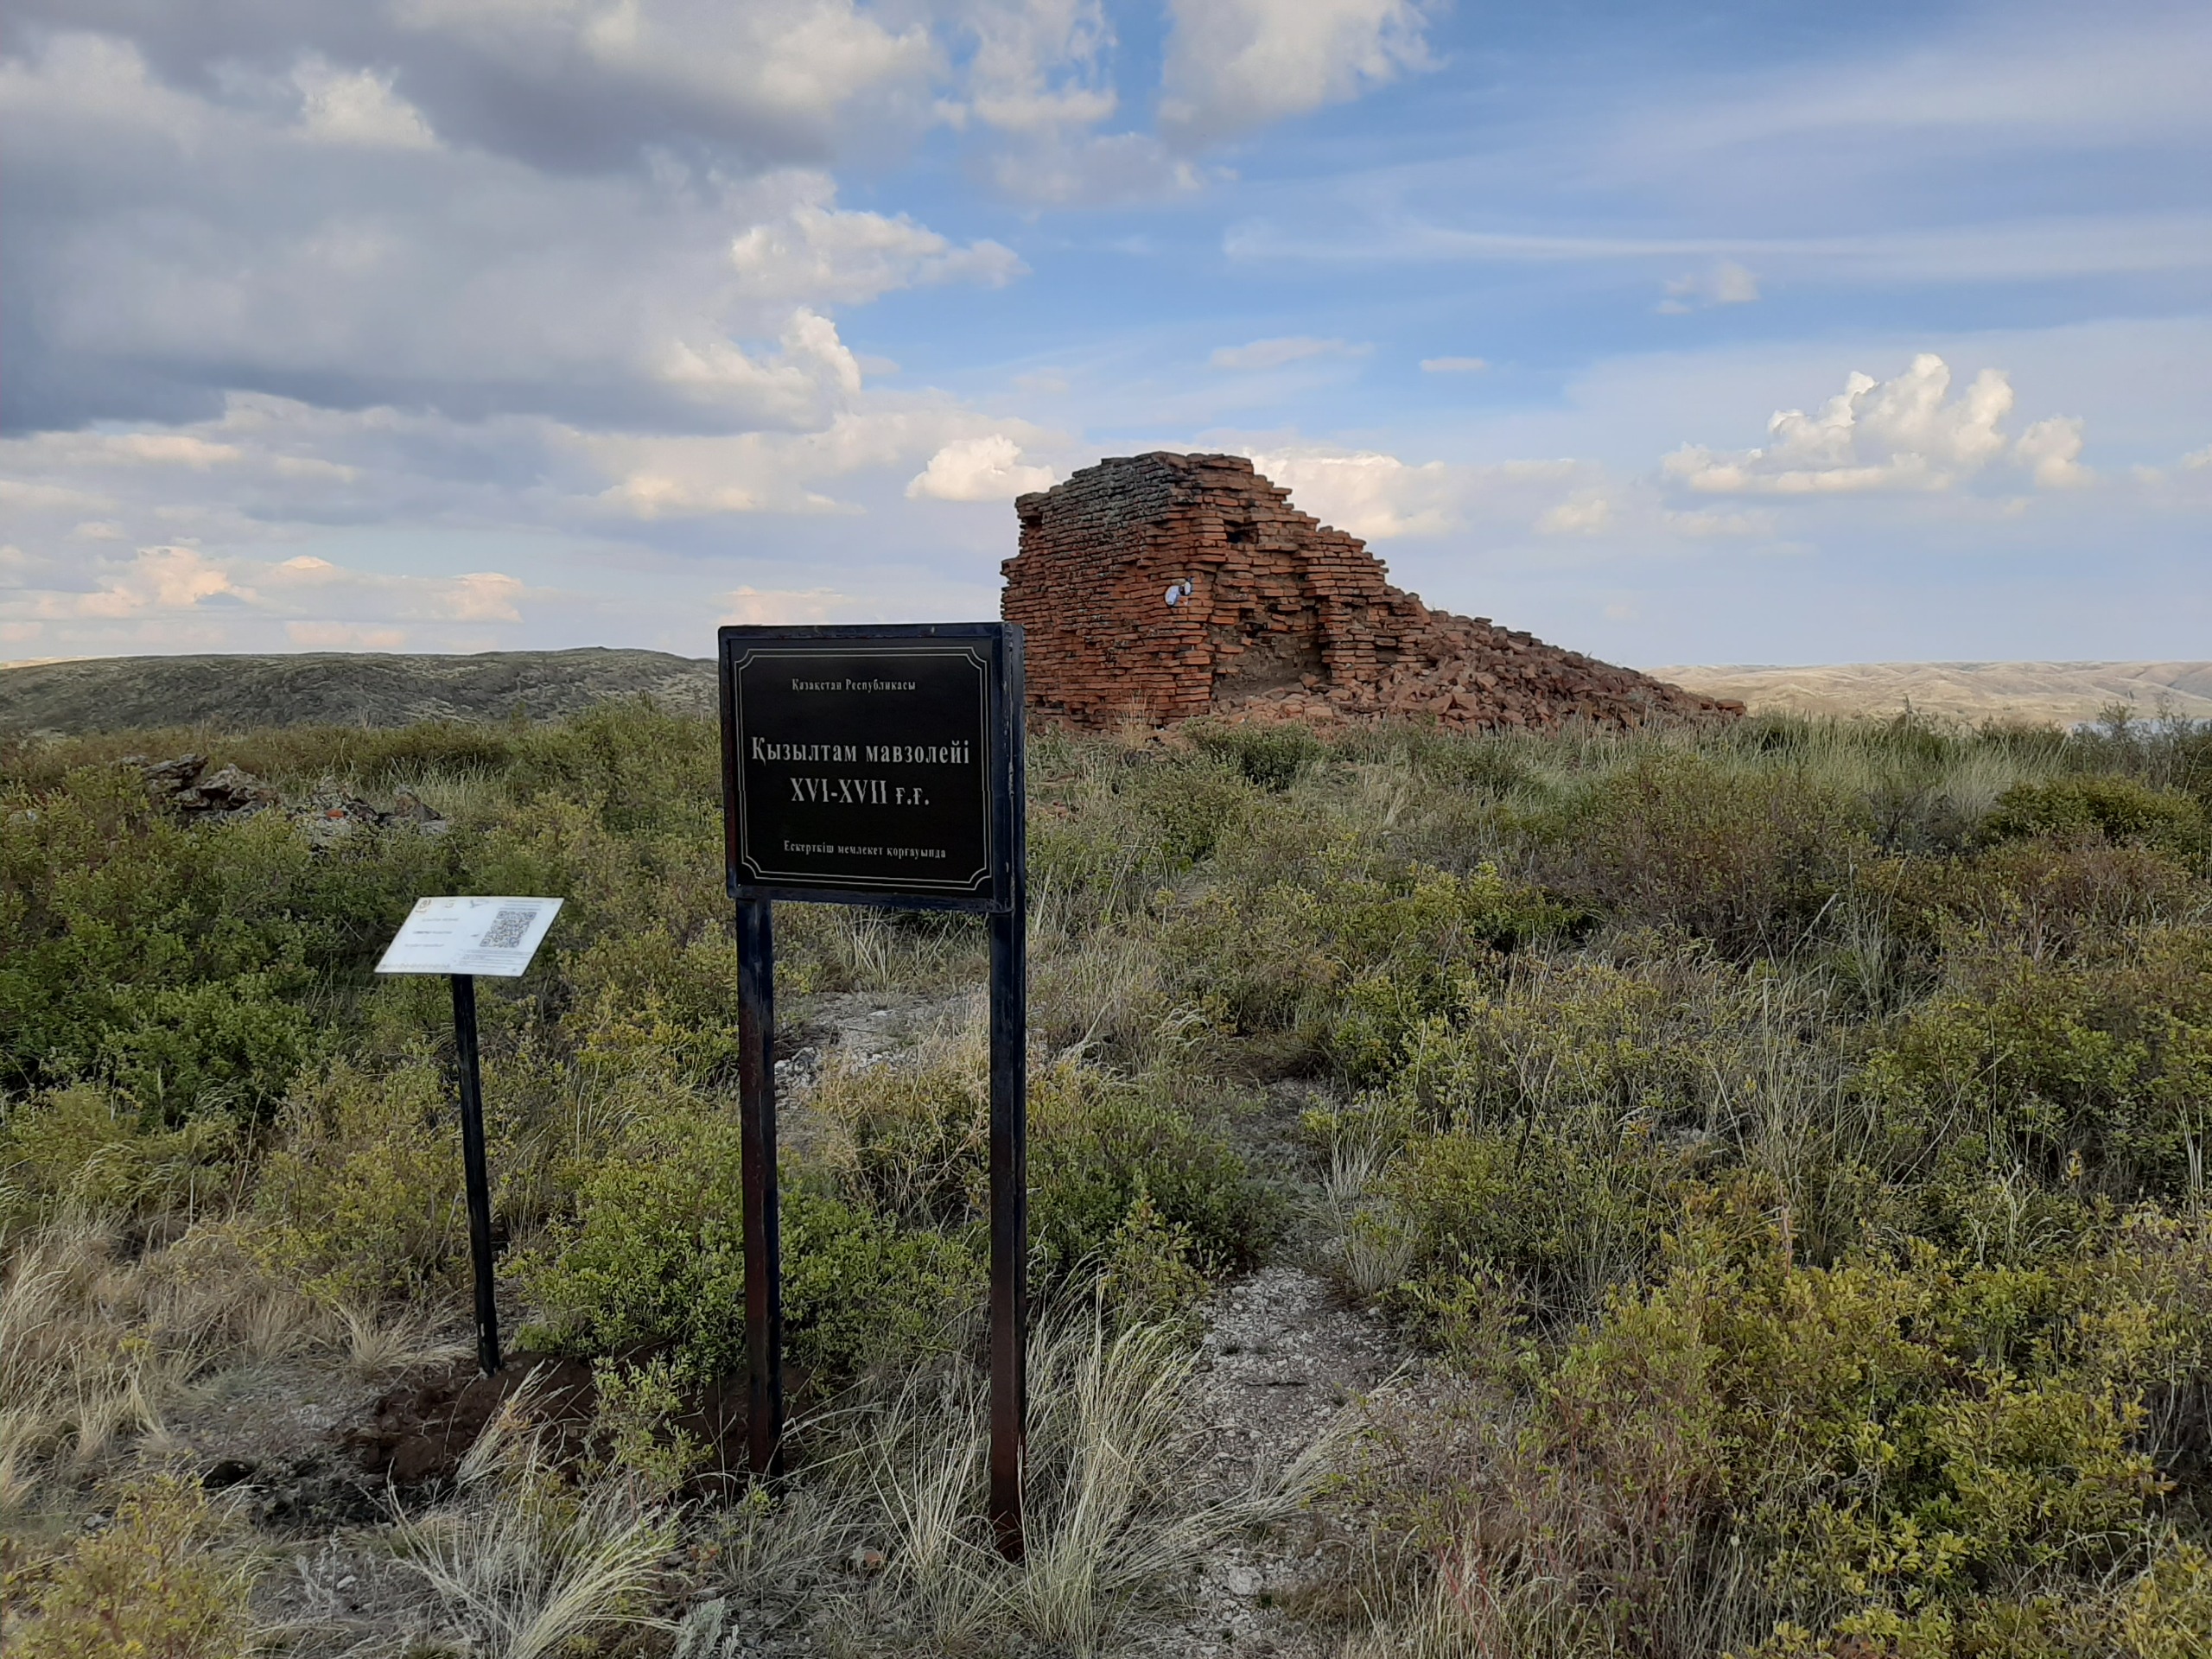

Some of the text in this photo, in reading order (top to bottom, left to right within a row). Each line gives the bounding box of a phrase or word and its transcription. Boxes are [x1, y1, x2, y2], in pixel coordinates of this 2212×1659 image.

[791, 678, 915, 692] Қазақстан Республикасы
[752, 736, 969, 766] Қызылтам мавзолейі
[790, 778, 887, 804] XVI-XVII
[784, 840, 946, 860] Ескерткіш мемлекет қорғауында
